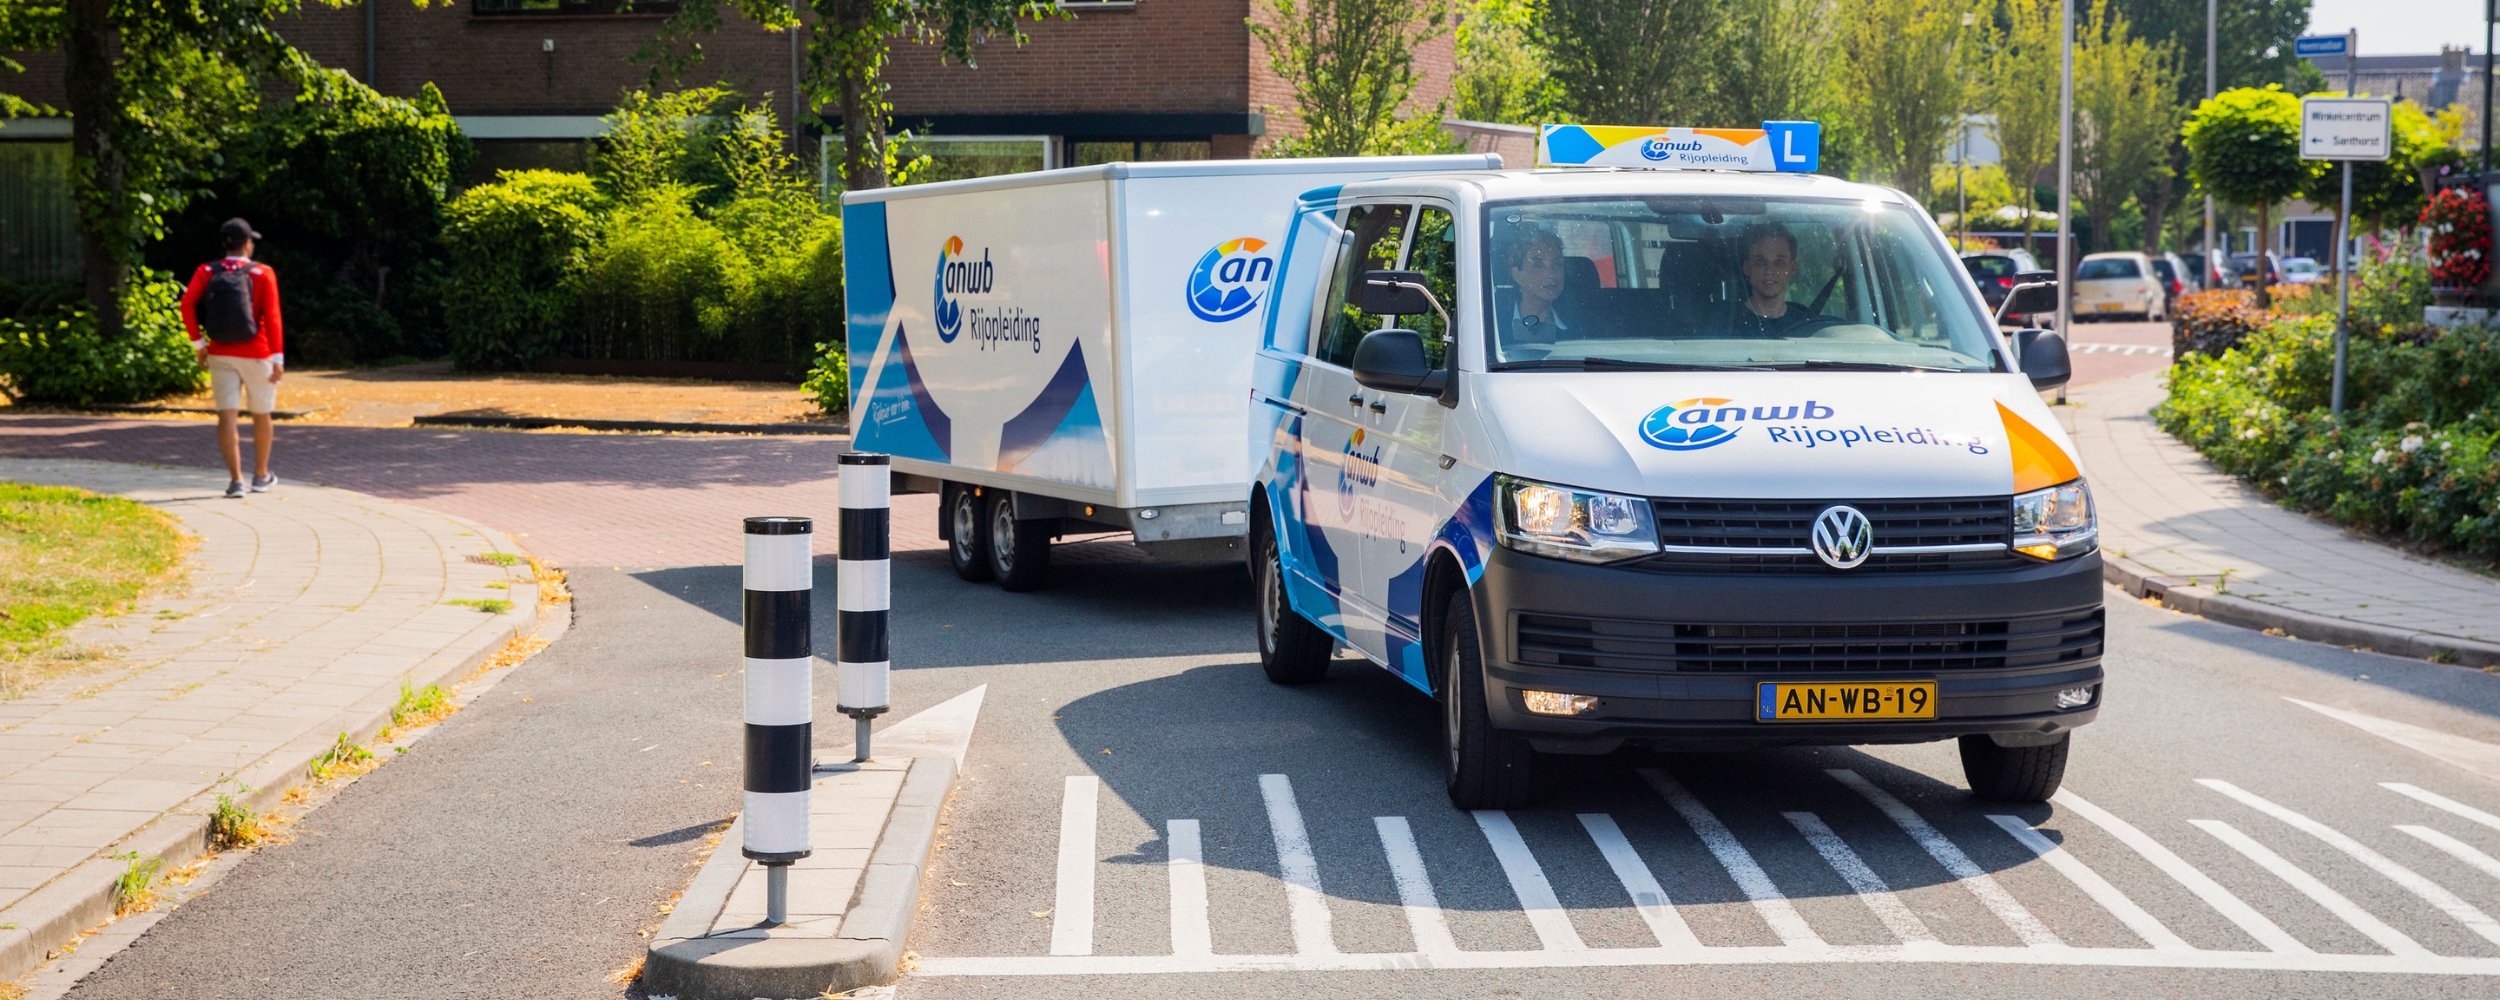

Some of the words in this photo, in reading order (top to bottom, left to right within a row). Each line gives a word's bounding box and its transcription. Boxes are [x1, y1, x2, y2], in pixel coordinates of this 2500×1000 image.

[2311, 112, 2381, 121] Winkelcentrum
[1653, 140, 1703, 151] anwb
[1783, 130, 1806, 163] L
[2332, 135, 2380, 146] Santhorst
[1679, 153, 1749, 165] Rijopleiding
[945, 247, 993, 294] anwb
[970, 306, 1041, 354] Rijopleiding
[1677, 400, 1835, 424] anwb
[1346, 445, 1380, 488] anwb
[1360, 497, 1406, 554] Rijopleiding
[1761, 704, 1774, 714] NL
[1781, 687, 1928, 714] AN-WB-19
